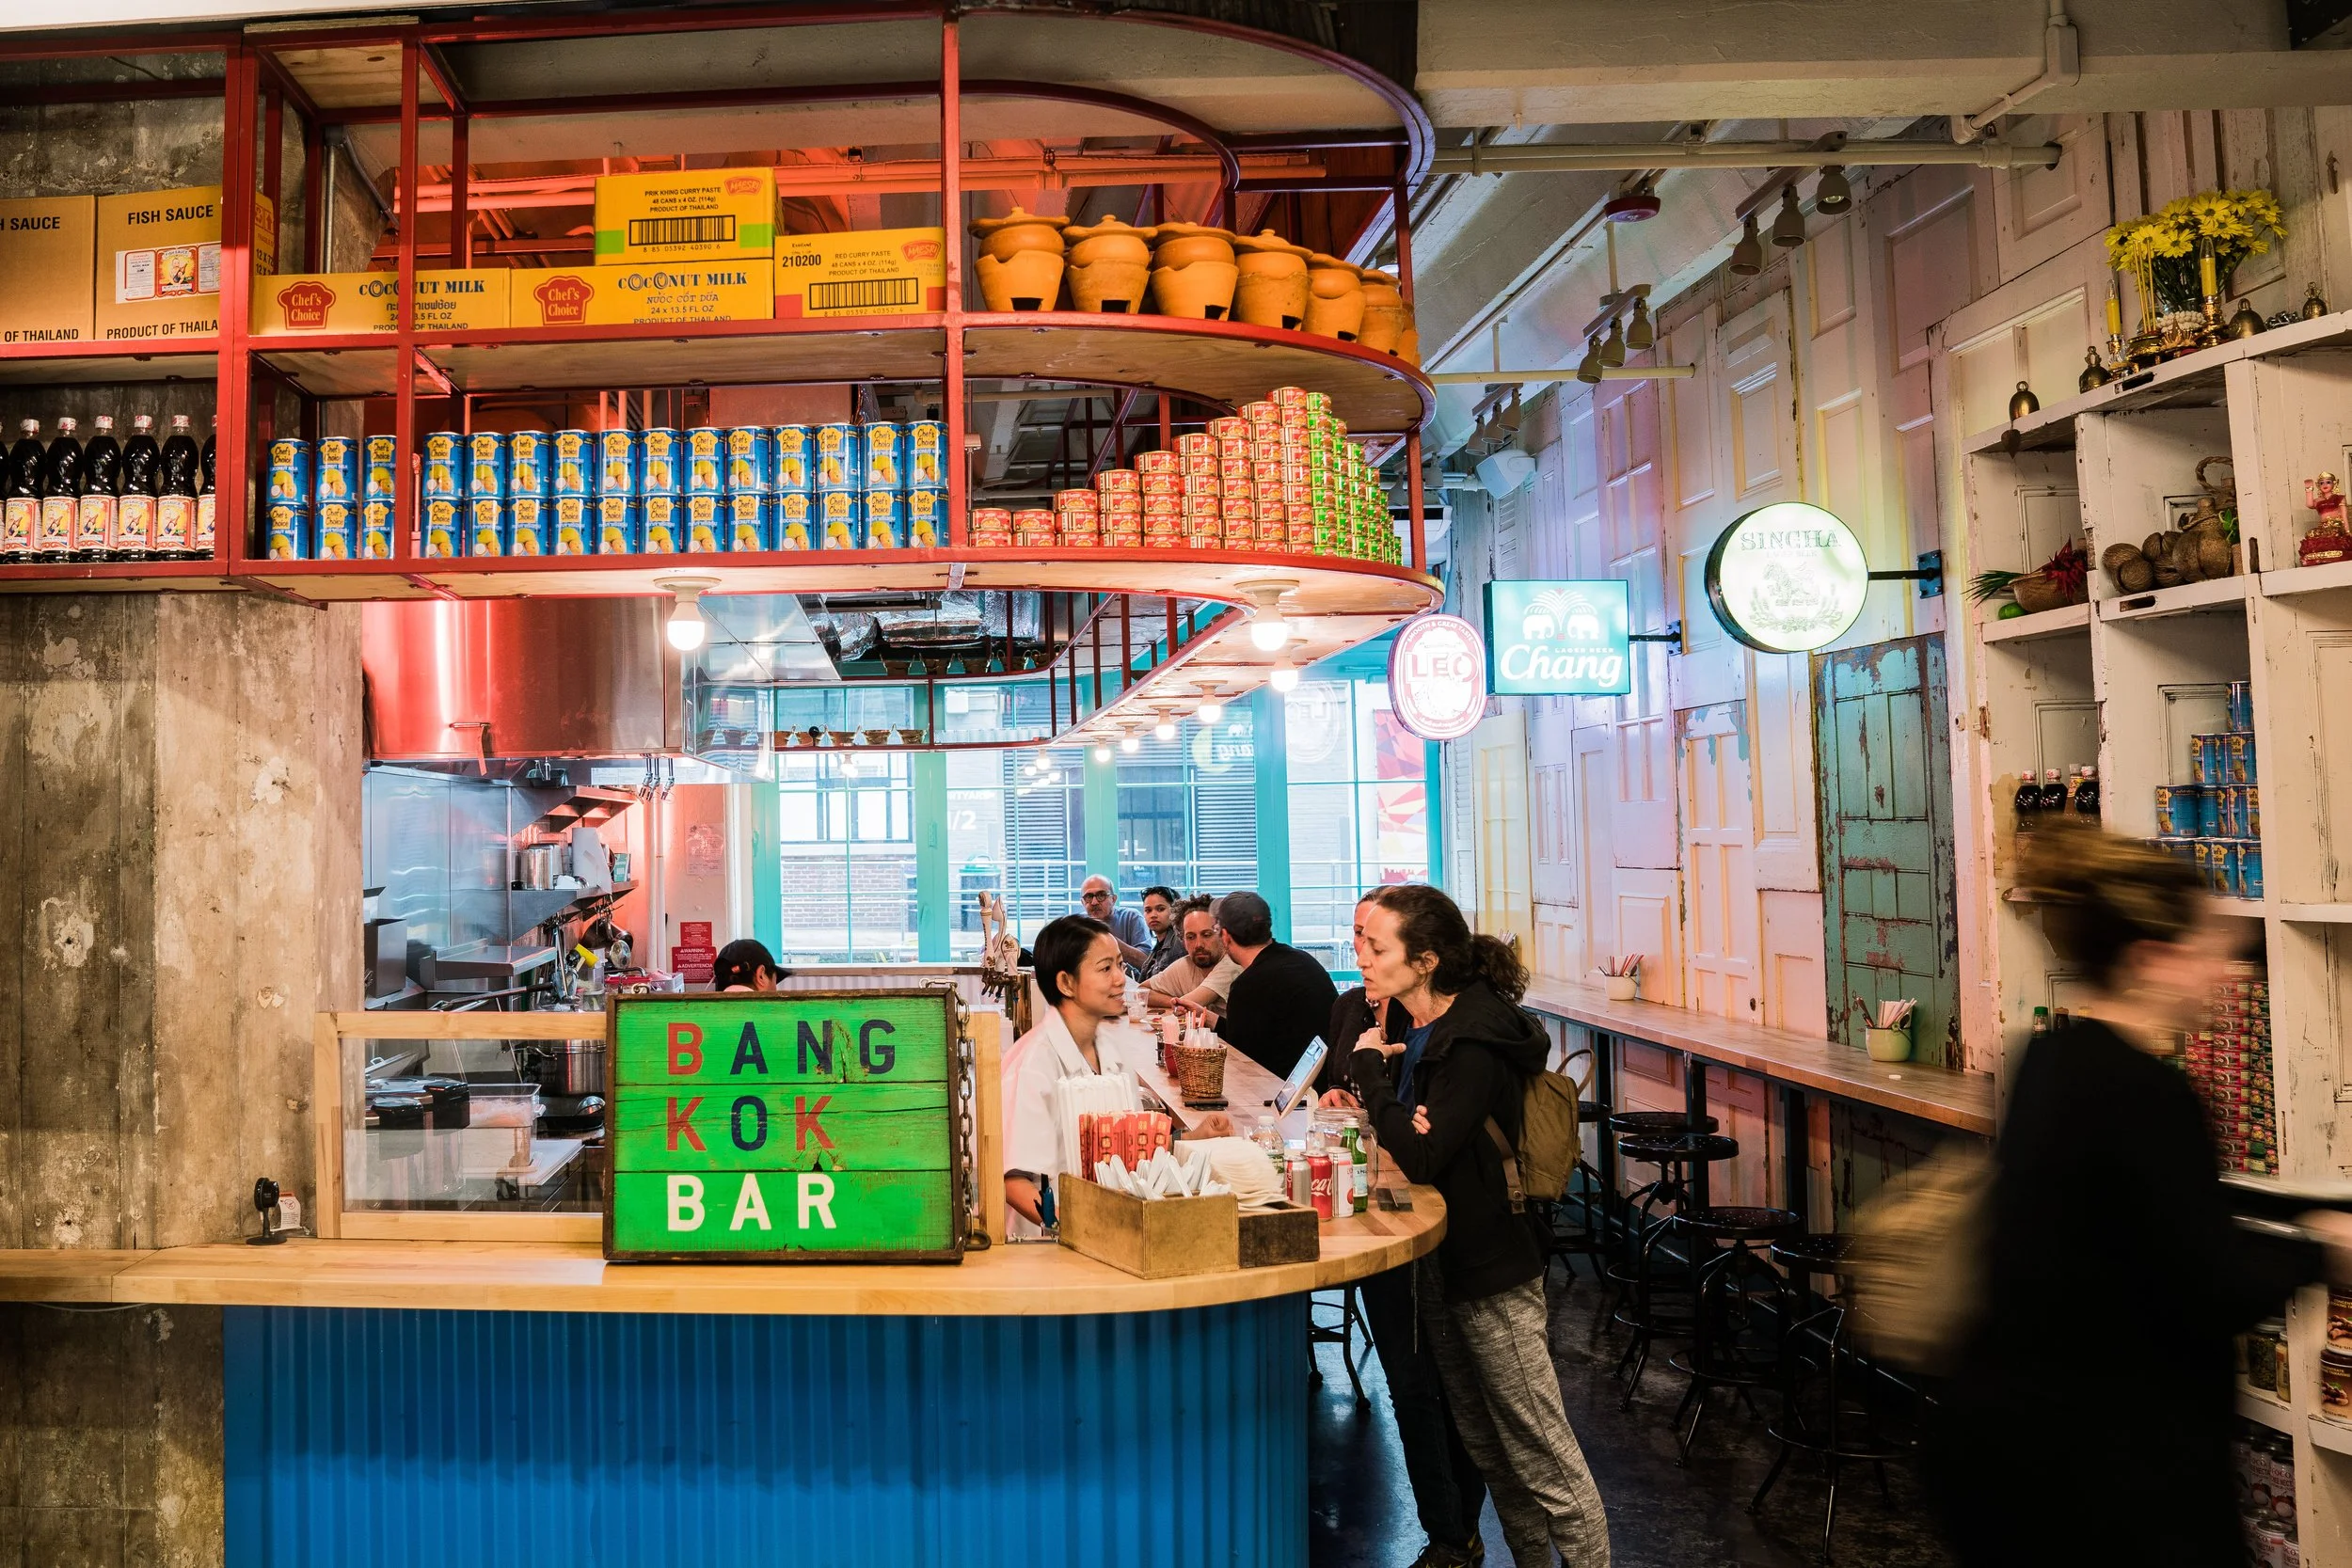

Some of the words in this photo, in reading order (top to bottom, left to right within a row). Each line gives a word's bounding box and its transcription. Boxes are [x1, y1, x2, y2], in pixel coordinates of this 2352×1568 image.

[10, 216, 60, 230] SAUCE
[128, 211, 160, 225] FISH
[166, 205, 214, 220] SAUCE
[783, 254, 821, 267] 210200
[359, 280, 440, 297] COCUT
[445, 280, 485, 295] MILK
[617, 271, 701, 292] COCONUT
[707, 272, 747, 286] MILK
[292, 293, 322, 307] Chef's
[548, 288, 580, 303] Chef's
[291, 308, 322, 322] Choice
[548, 303, 580, 316] Choice
[5, 331, 19, 342] OF
[23, 329, 79, 341] THAILAND
[107, 325, 158, 340] PRODUCT
[163, 324, 176, 335] OF
[180, 320, 218, 333] THAILA
[428, 323, 469, 331] THAILAND
[1740, 530, 1841, 551] SINGHA
[1458, 626, 1475, 642] TASTE
[1405, 651, 1480, 684] LEO
[1500, 643, 1623, 689] Chang
[667, 1020, 896, 1076] BANG
[666, 1095, 836, 1151] KOK
[667, 1173, 837, 1231] BAR
